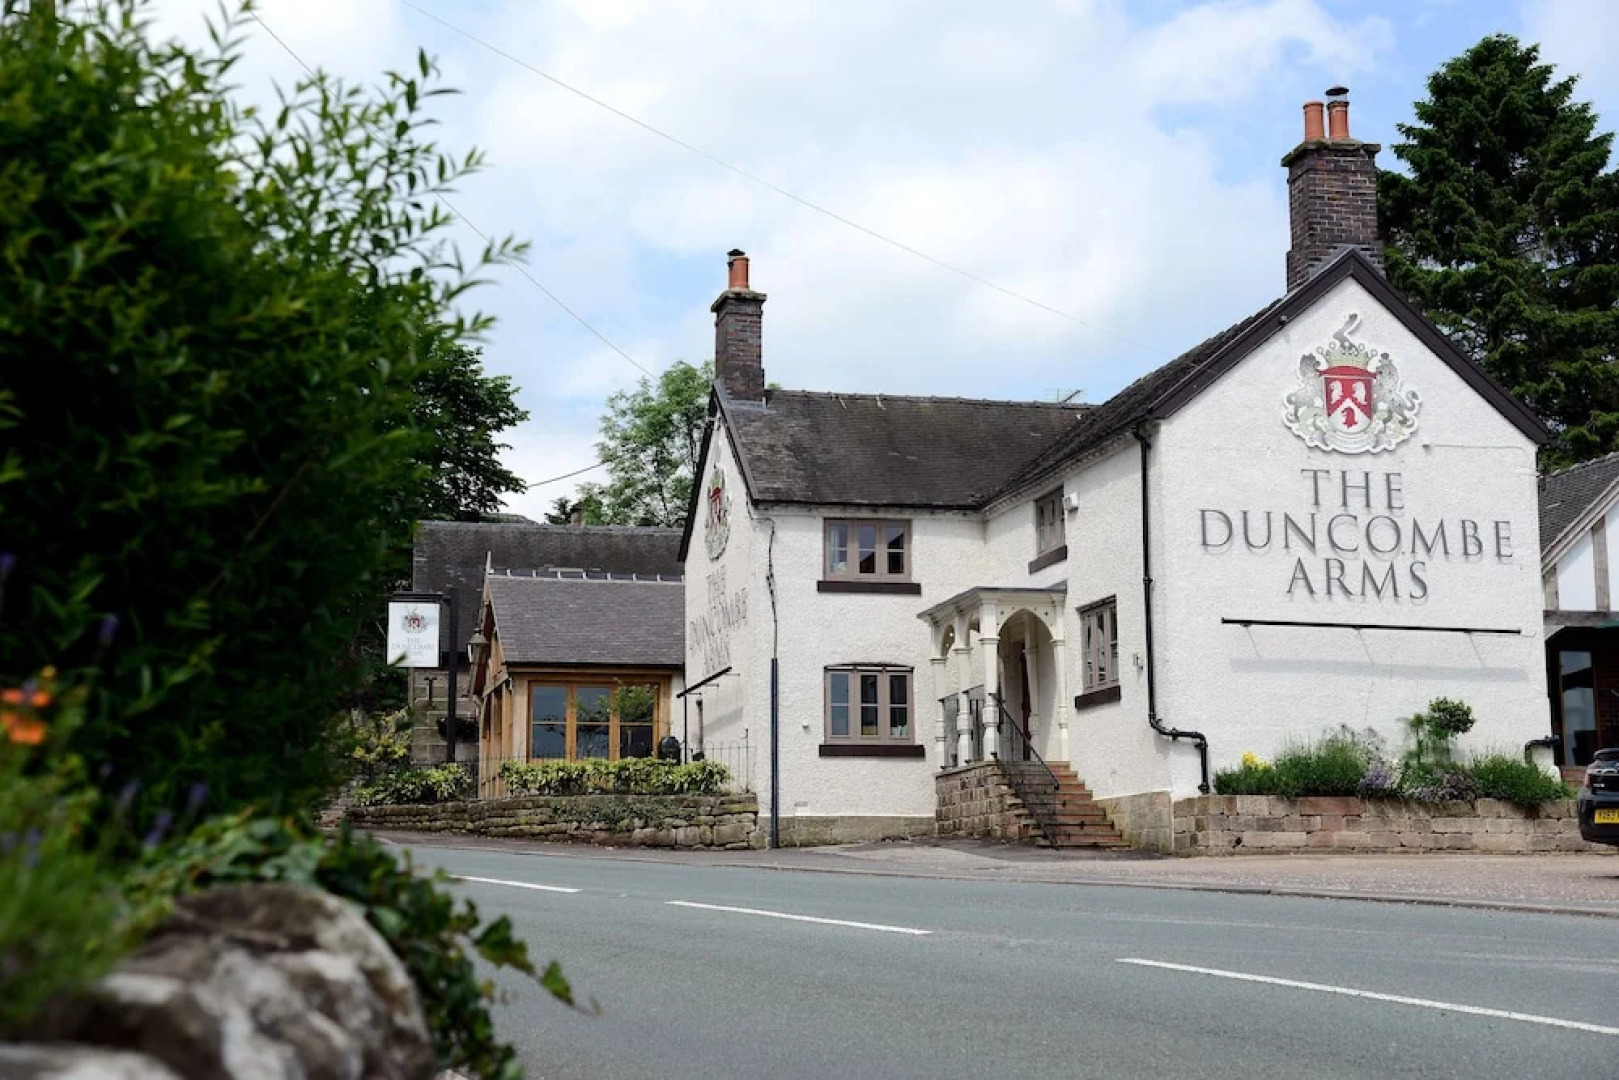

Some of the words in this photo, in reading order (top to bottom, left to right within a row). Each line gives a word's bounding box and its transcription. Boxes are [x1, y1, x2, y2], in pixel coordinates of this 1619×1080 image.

[1301, 468, 1404, 509] THE
[1199, 508, 1513, 558] DUNCOMBE
[1286, 557, 1428, 599] ARMS
